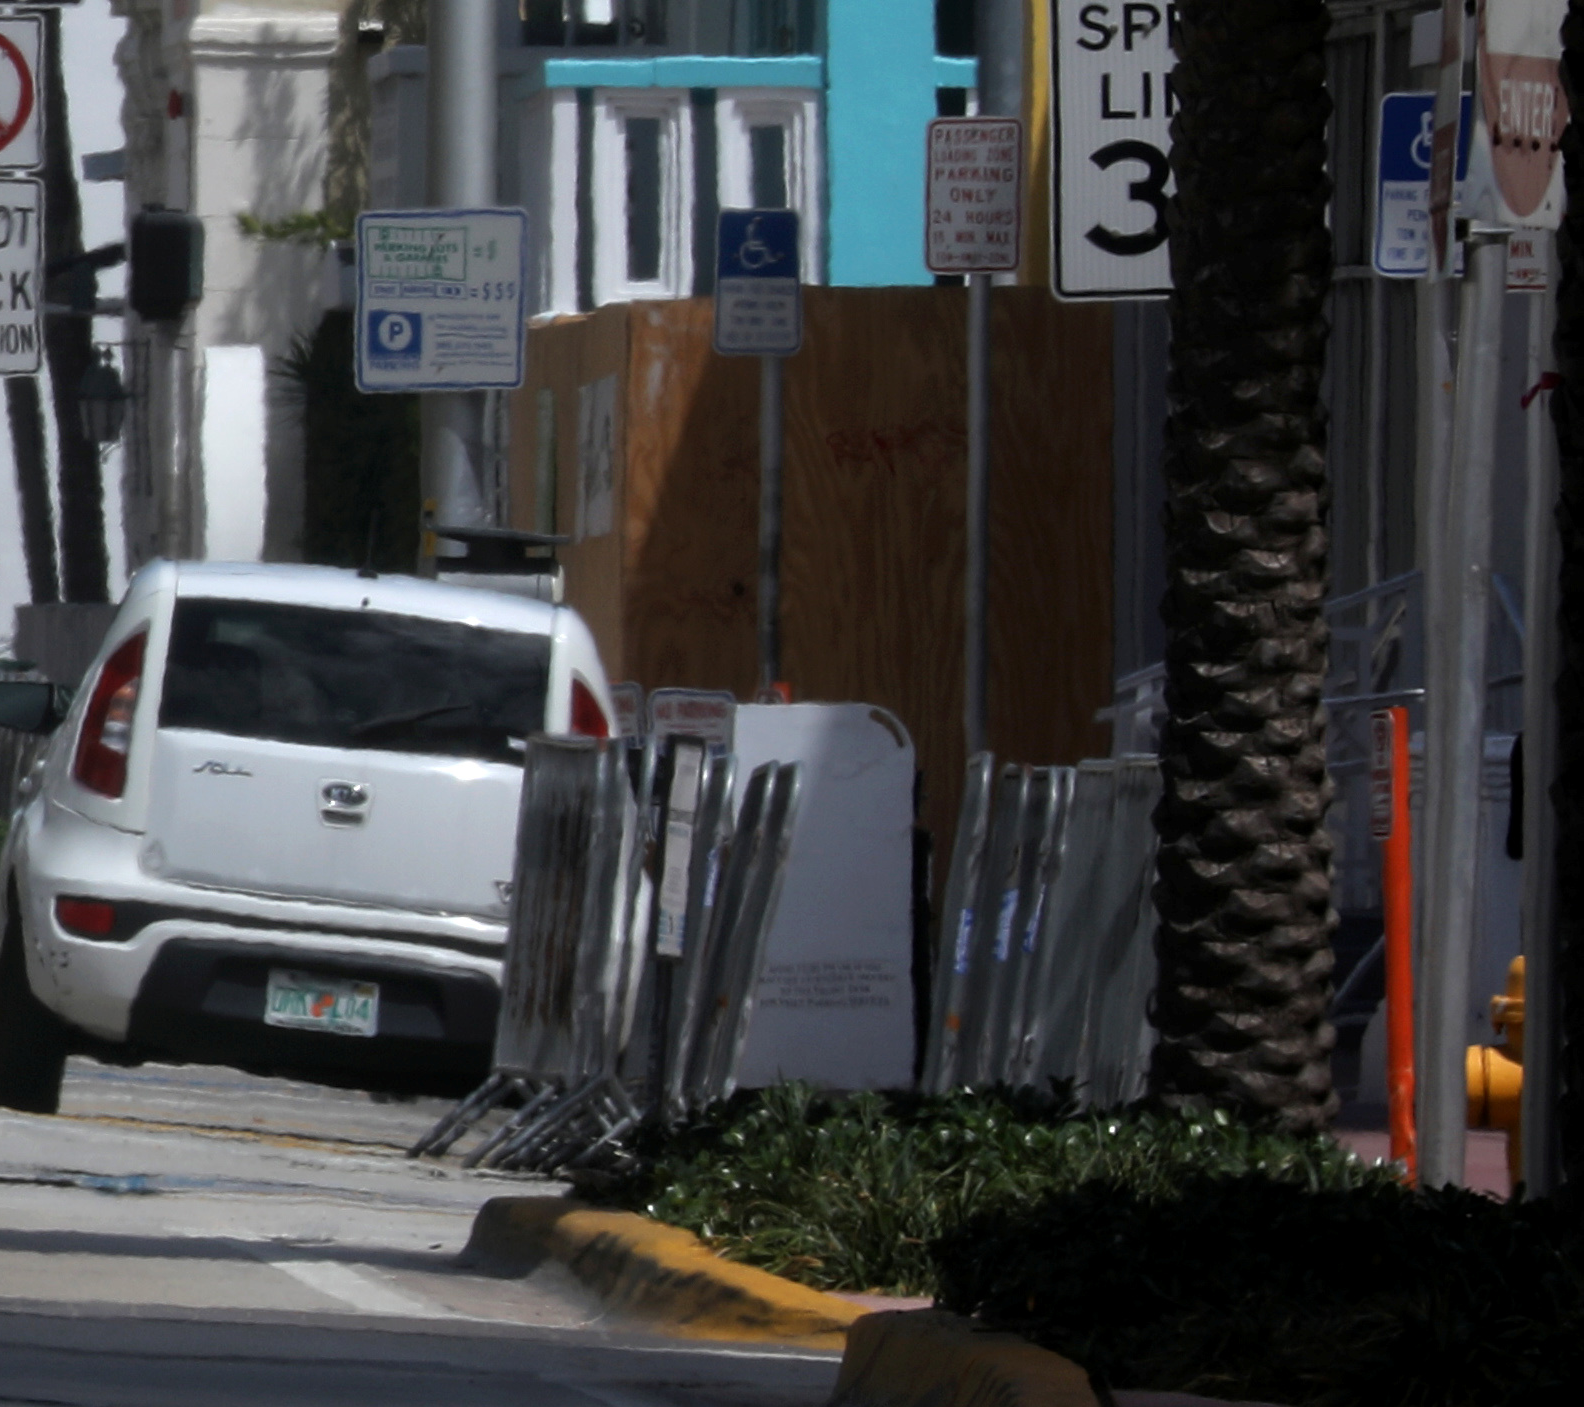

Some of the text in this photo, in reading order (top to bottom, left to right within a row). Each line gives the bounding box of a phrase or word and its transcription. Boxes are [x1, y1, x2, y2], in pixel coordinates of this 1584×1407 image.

[1499, 78, 1553, 139] ENTER
[934, 127, 1015, 145] PASSENGER
[934, 167, 1014, 182] PARKING
[950, 186, 996, 203] ONLY
[932, 209, 1014, 225] 24 HOURS
